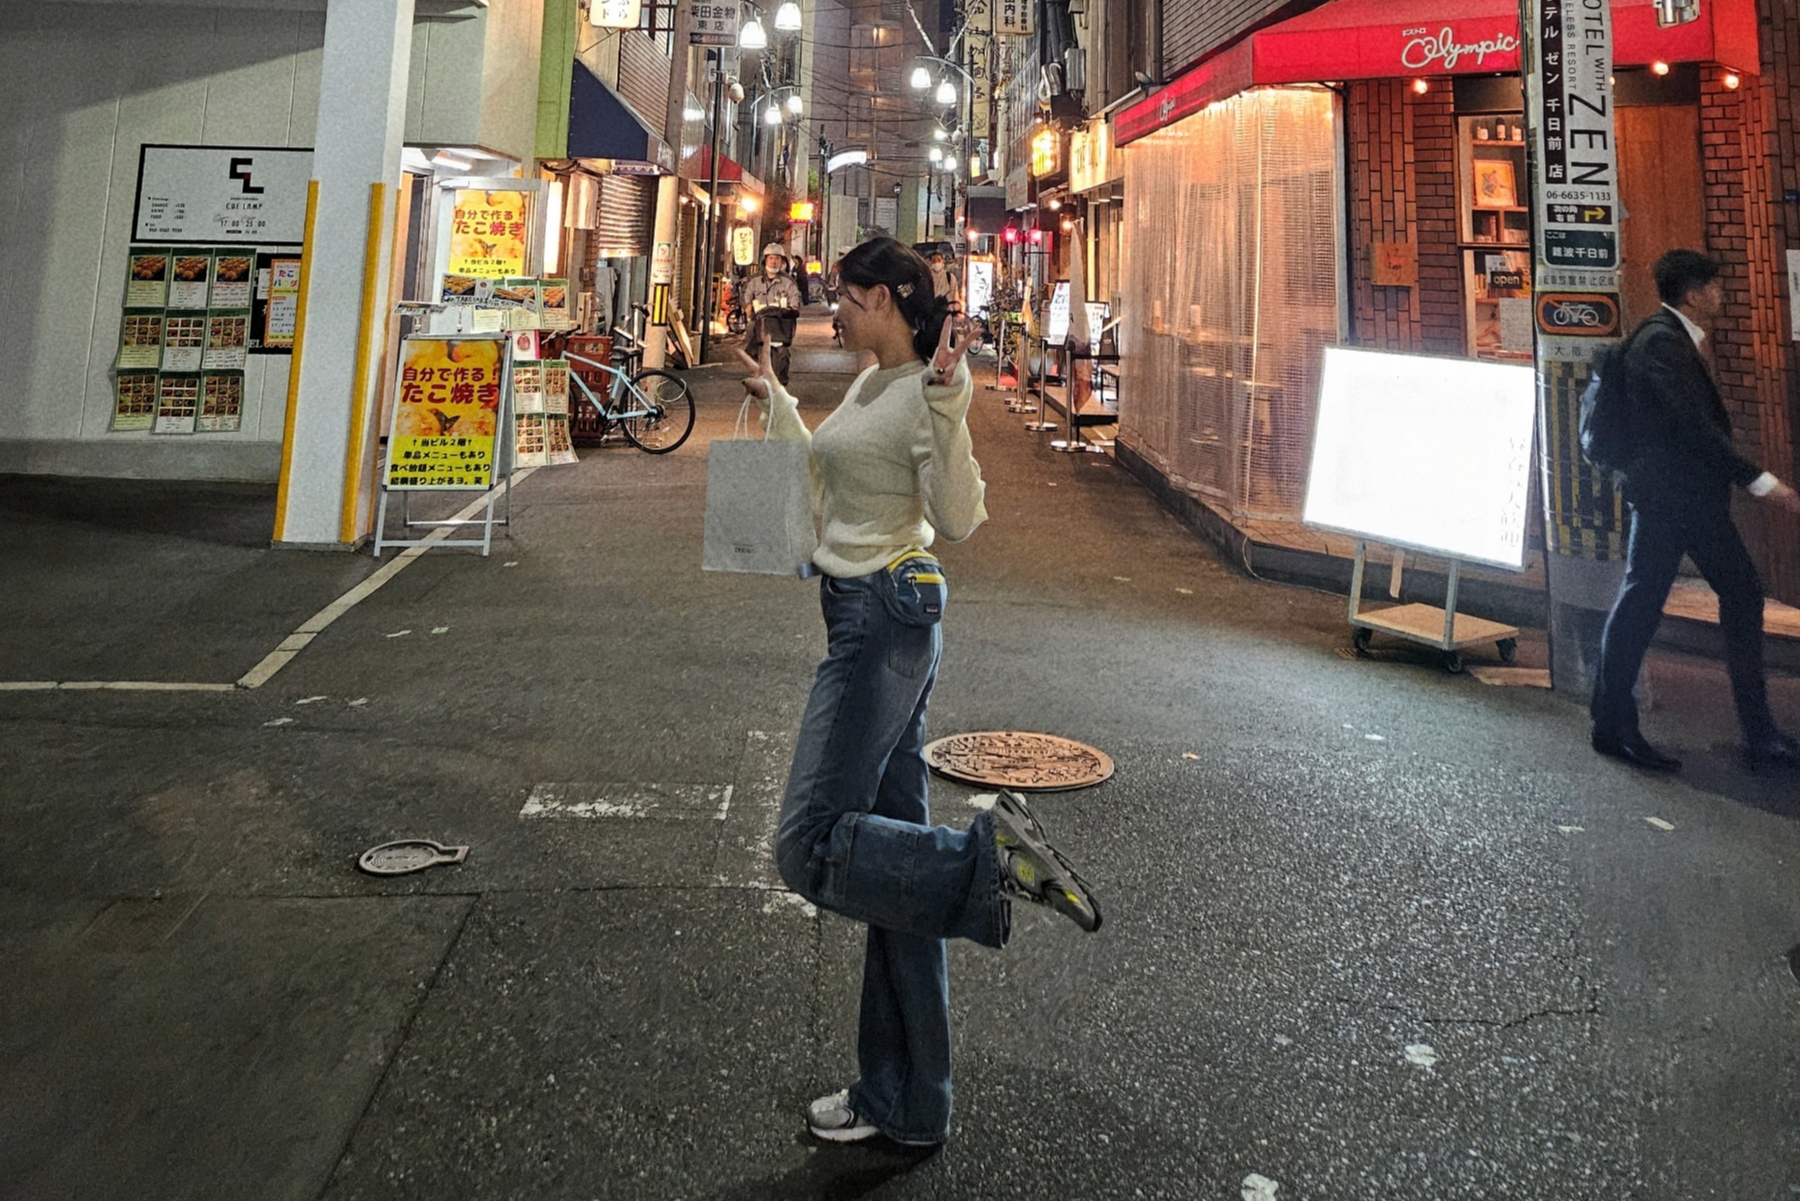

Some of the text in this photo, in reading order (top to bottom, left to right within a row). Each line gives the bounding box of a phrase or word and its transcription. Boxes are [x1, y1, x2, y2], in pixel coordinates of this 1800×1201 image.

[1401, 26, 1519, 69] Olympic
[1566, 43, 1577, 90] RESORT
[1595, 57, 1605, 92] WITH
[1568, 93, 1610, 186] ZEN
[1546, 190, 1611, 201] 06-6635-1133
[455, 220, 525, 237] たこ焼き
[1493, 273, 1520, 285] open
[403, 366, 497, 382] 自分で作る！
[402, 382, 498, 405] たこ焼き
[403, 450, 486, 460] 単品メニューもあり
